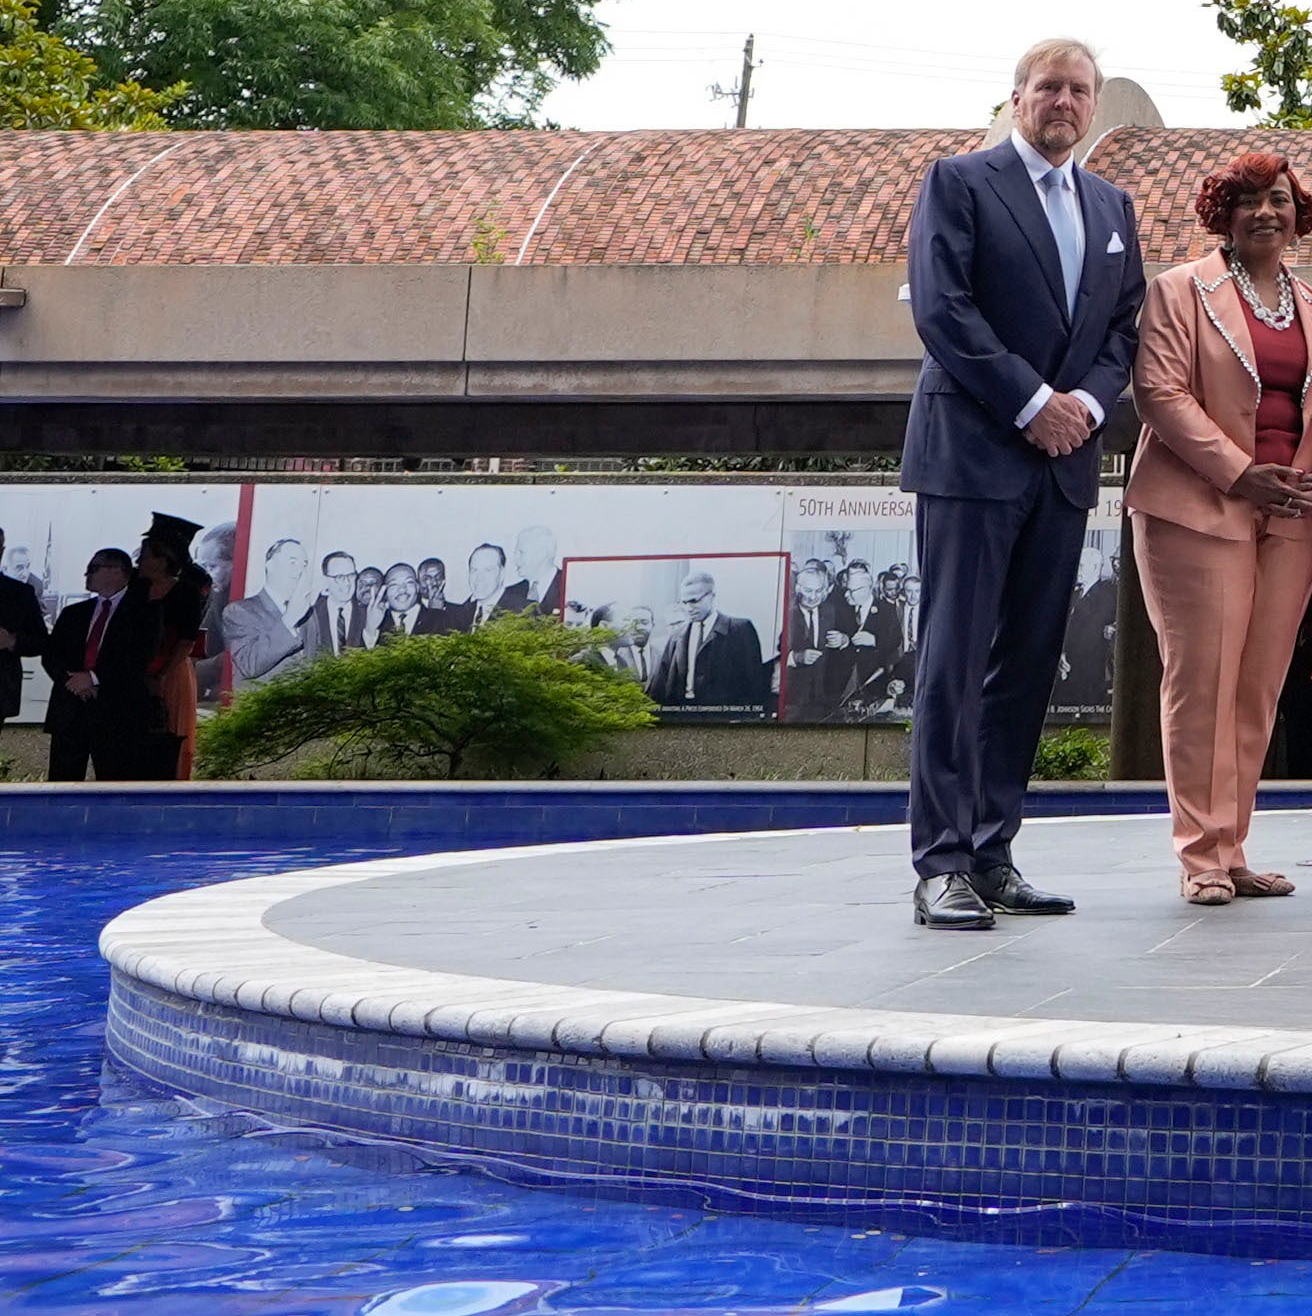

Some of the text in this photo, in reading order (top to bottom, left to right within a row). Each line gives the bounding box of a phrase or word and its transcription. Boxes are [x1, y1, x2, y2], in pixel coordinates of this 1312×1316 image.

[799, 498, 914, 516] 50TH ANNIVERSA
[1106, 500, 1123, 517] 19
